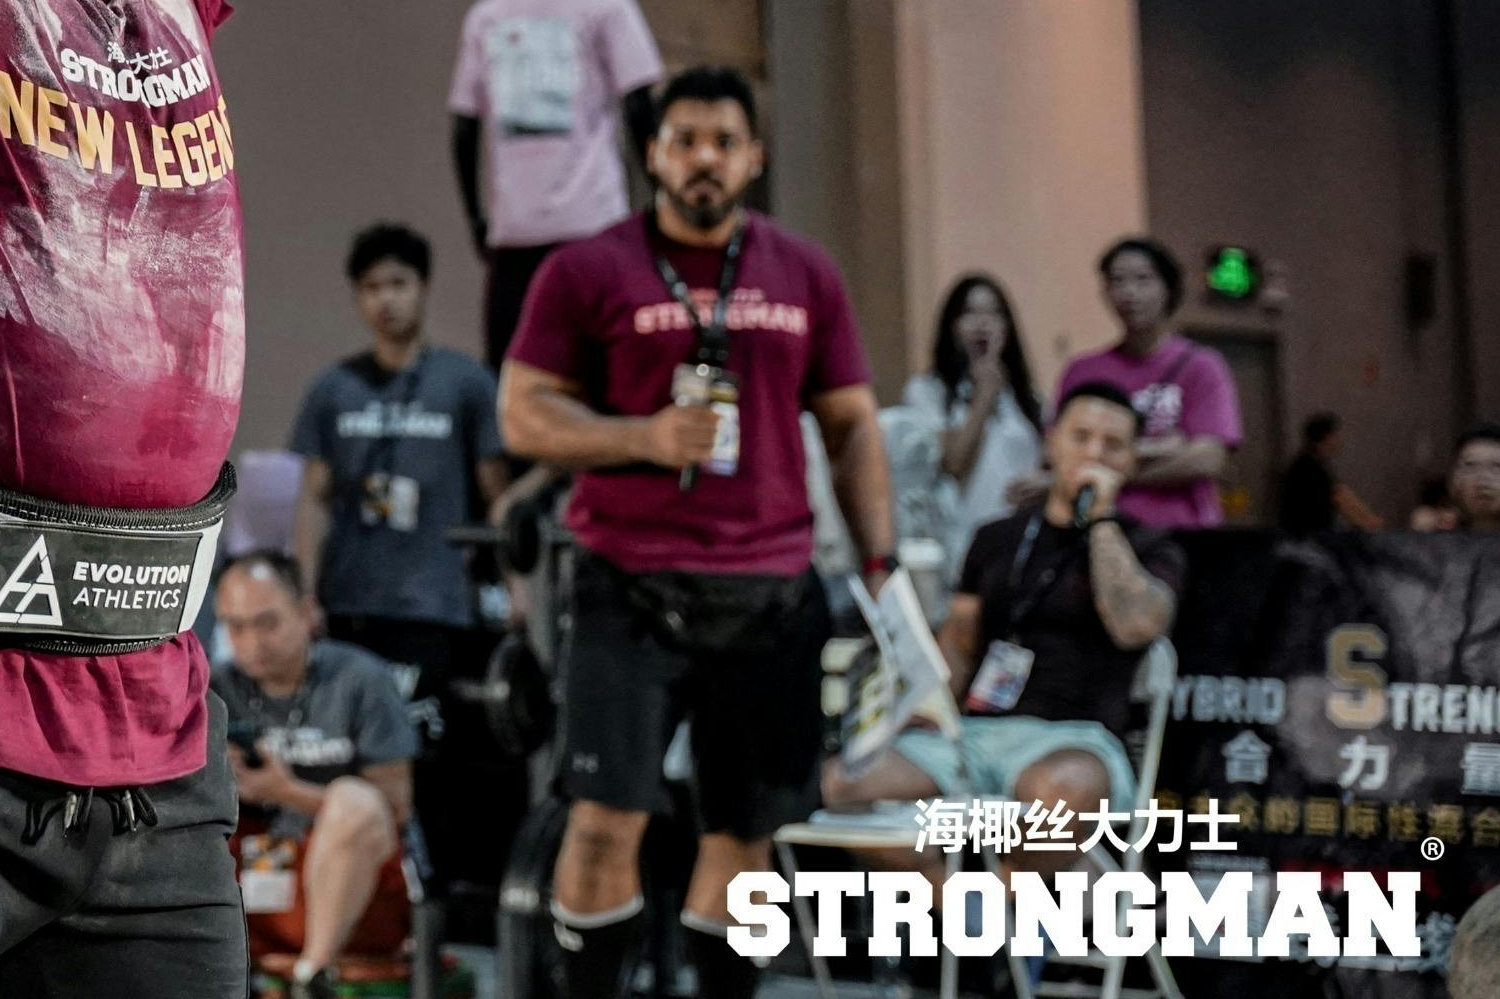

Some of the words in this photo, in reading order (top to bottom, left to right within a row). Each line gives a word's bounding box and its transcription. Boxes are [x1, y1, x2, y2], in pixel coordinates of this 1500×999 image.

[61, 48, 211, 108] STROGMAN
[73, 561, 190, 585] EVOLUTION
[73, 587, 181, 609] ATHLETICS
